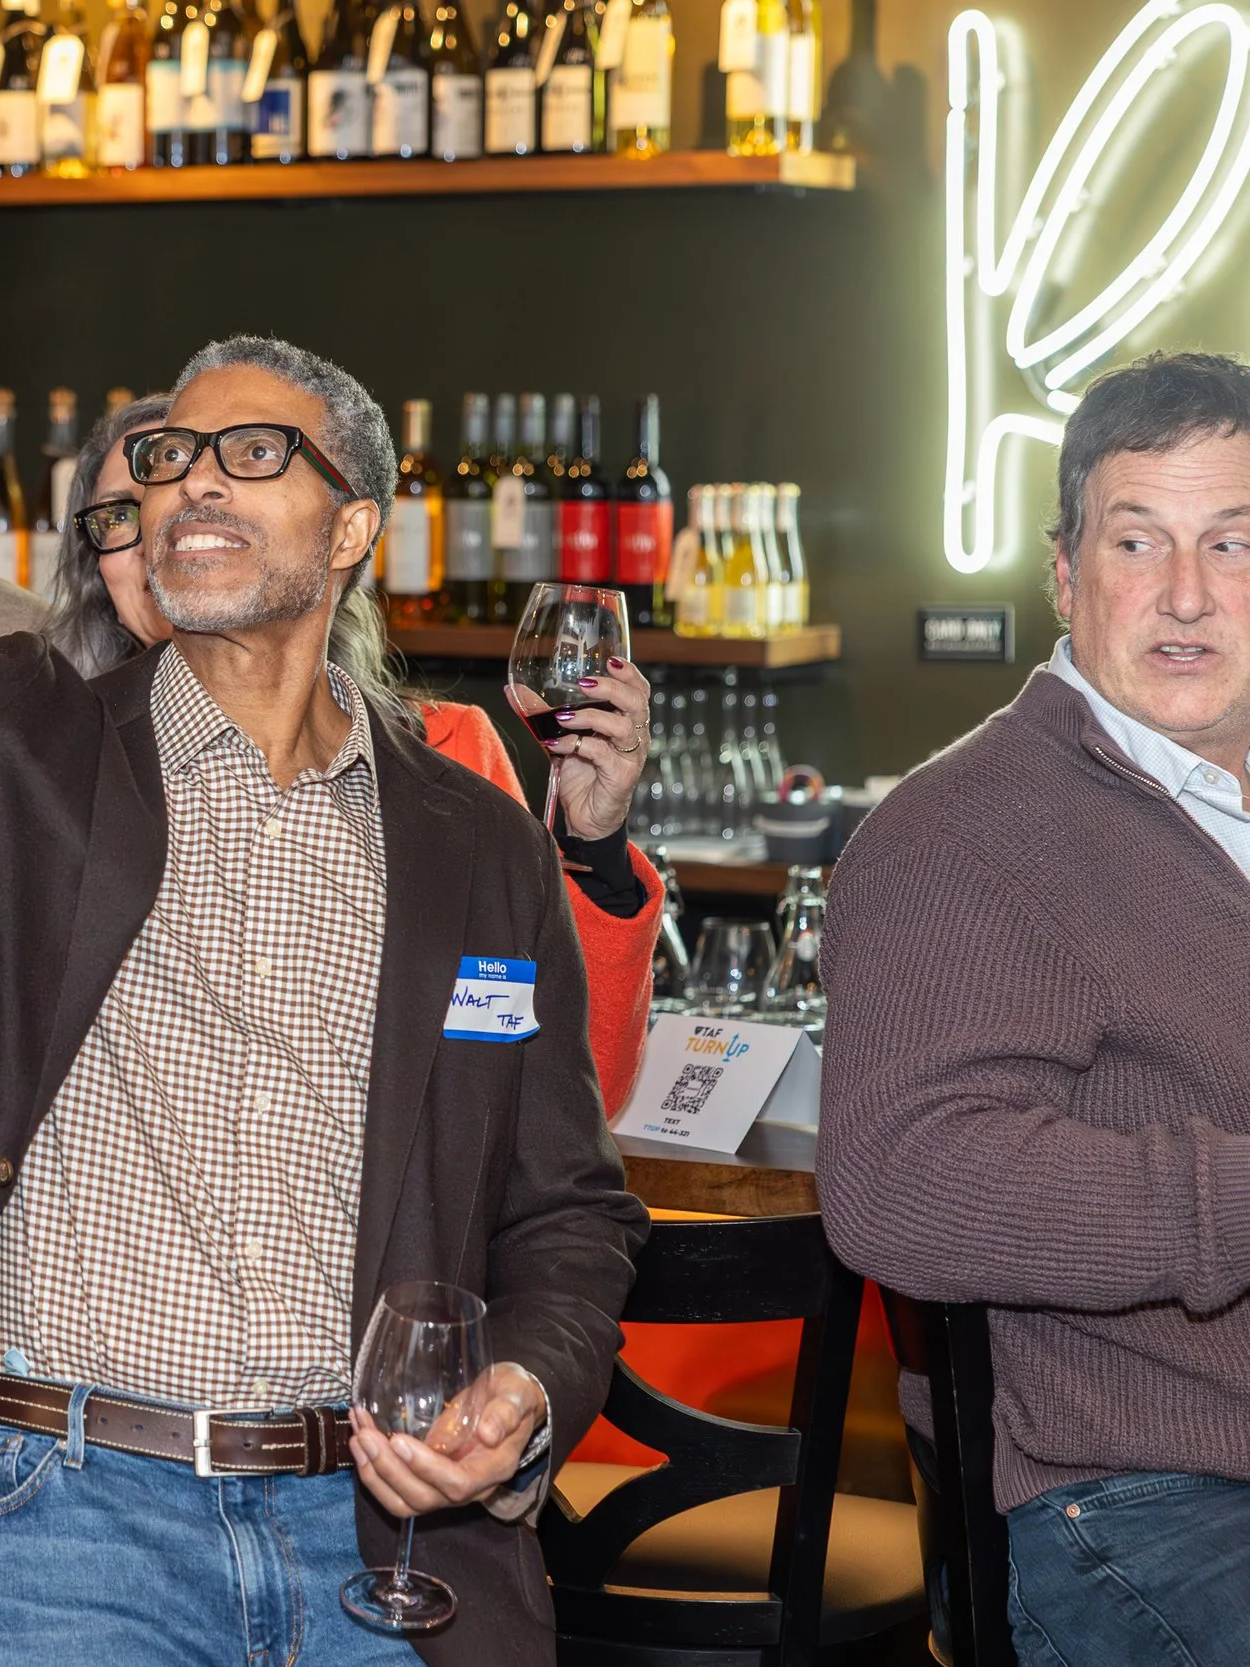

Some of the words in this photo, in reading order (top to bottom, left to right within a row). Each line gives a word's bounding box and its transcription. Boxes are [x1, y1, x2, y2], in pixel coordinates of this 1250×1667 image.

[478, 960, 507, 974] Hello
[451, 985, 510, 1009] WALT
[497, 1014, 524, 1031] TAF
[664, 1117, 681, 1125] TEXT
